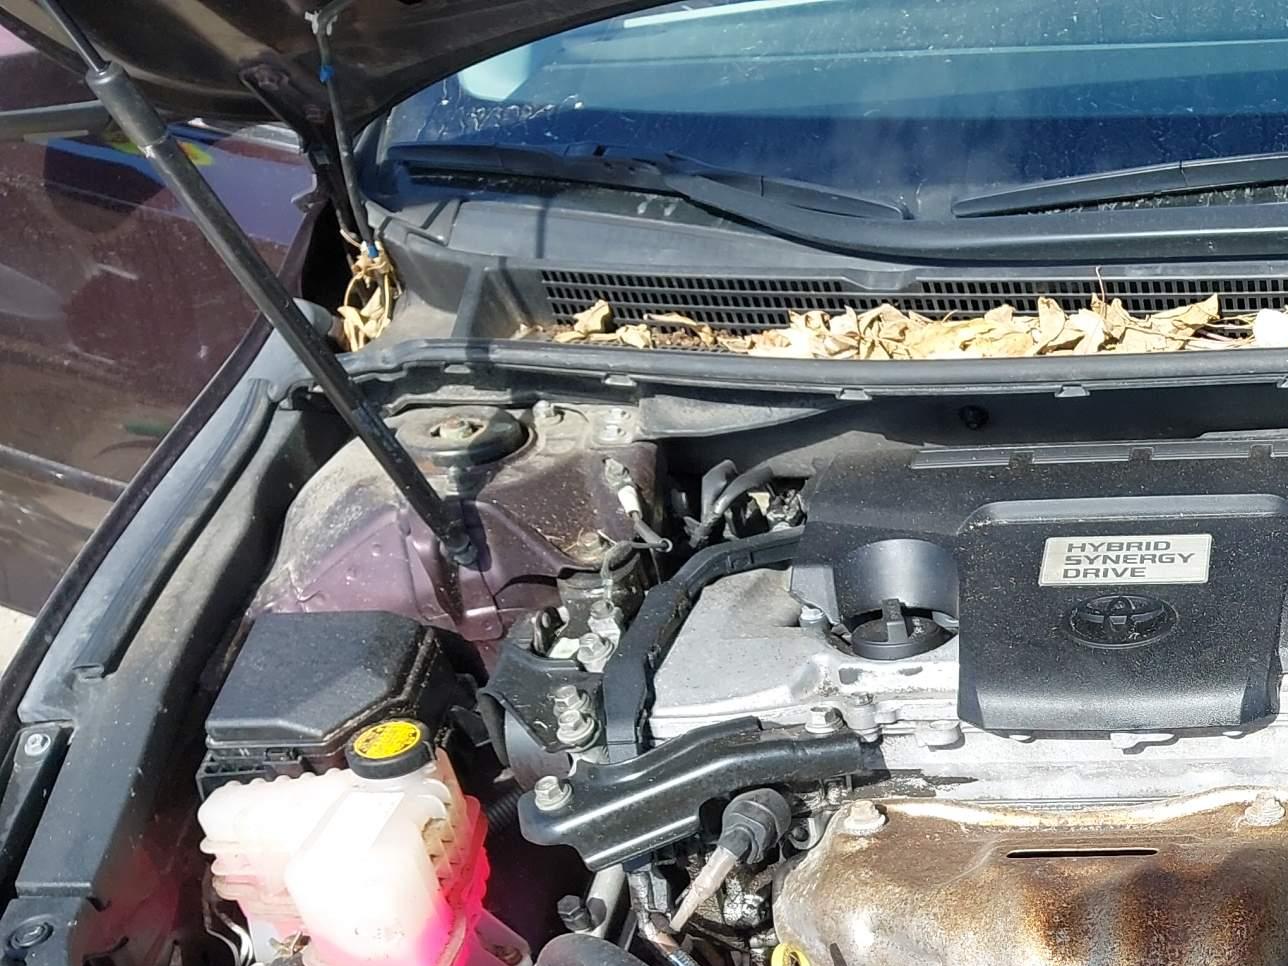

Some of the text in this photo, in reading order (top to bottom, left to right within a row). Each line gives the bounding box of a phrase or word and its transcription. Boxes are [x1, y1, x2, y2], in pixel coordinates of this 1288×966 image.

[1067, 541, 1171, 553] HYBRID
[1064, 552, 1196, 566] SYNERGY
[1062, 567, 1147, 579] DRIVE
